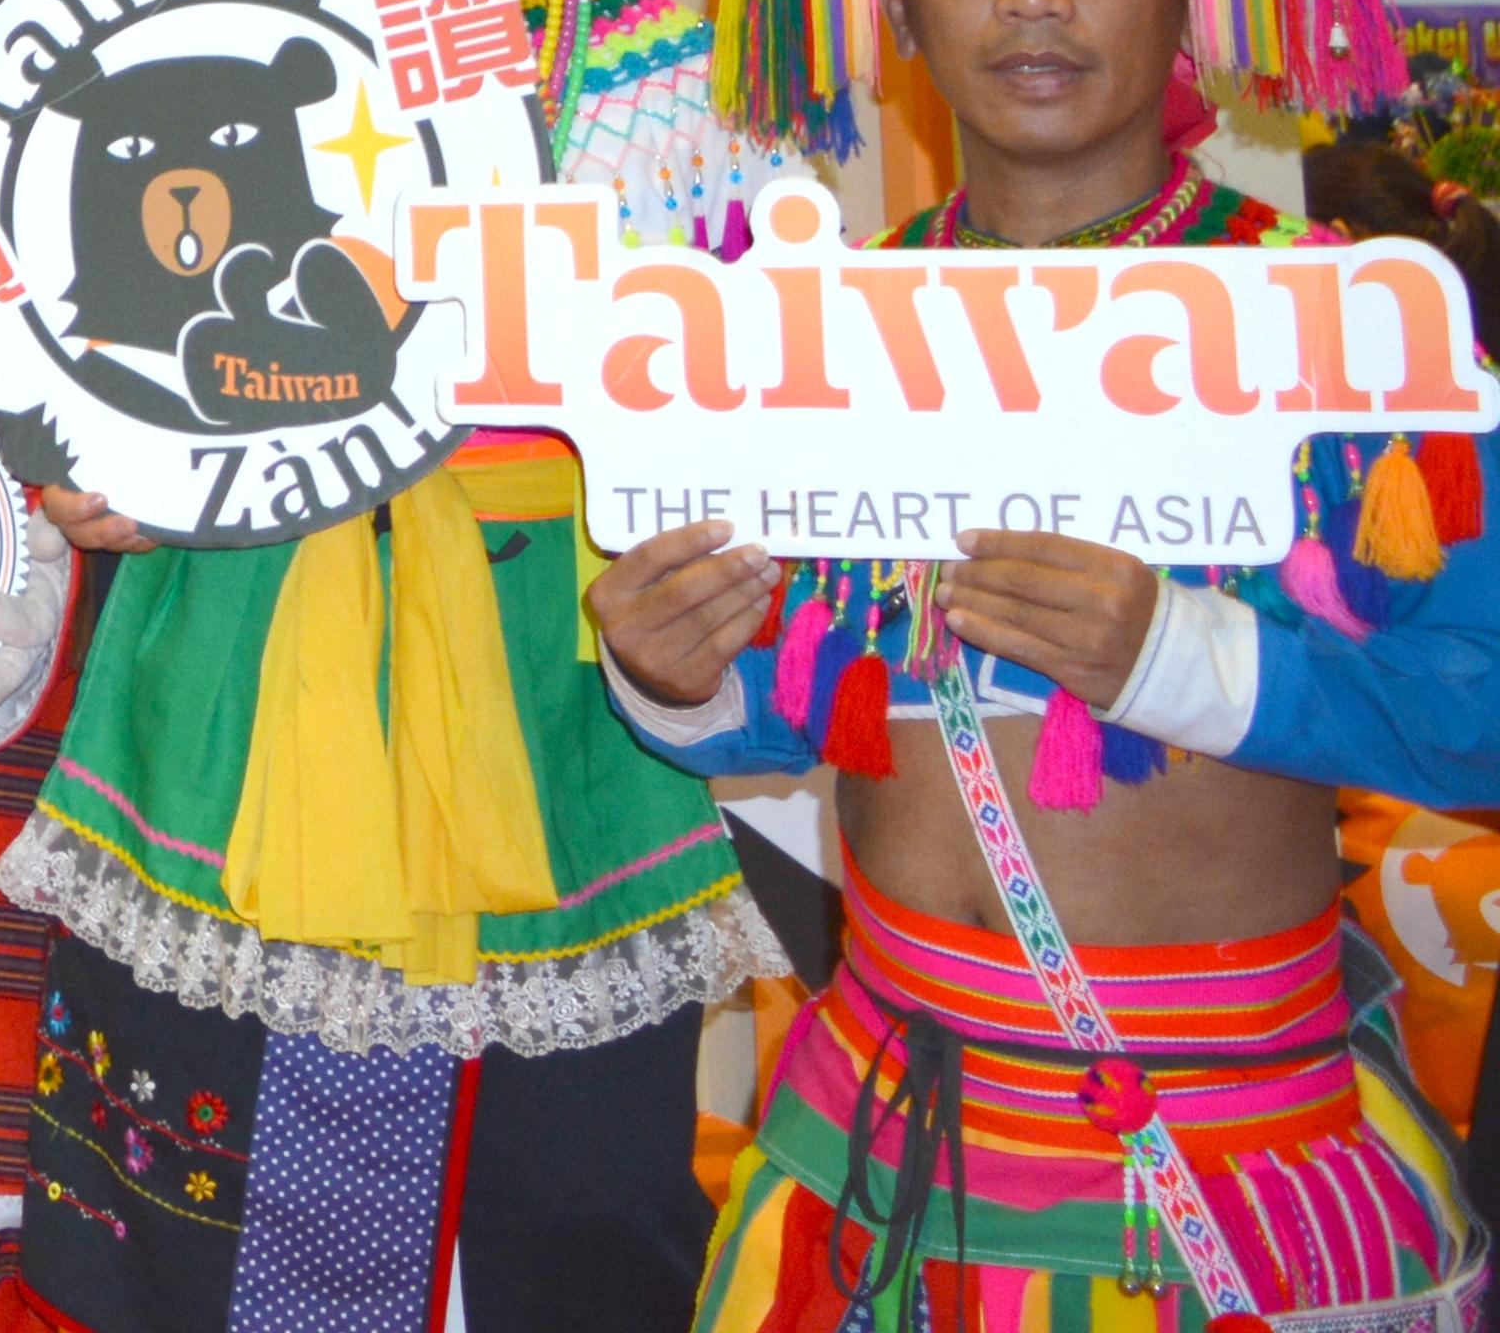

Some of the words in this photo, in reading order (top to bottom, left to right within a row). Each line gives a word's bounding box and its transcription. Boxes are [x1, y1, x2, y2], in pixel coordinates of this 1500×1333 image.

[410, 194, 1480, 413] Taiwan
[213, 354, 361, 402] Taiwan
[612, 487, 731, 533] THE
[760, 489, 972, 541] HEART
[998, 493, 1080, 534] OF
[1108, 494, 1266, 546] ASIA
